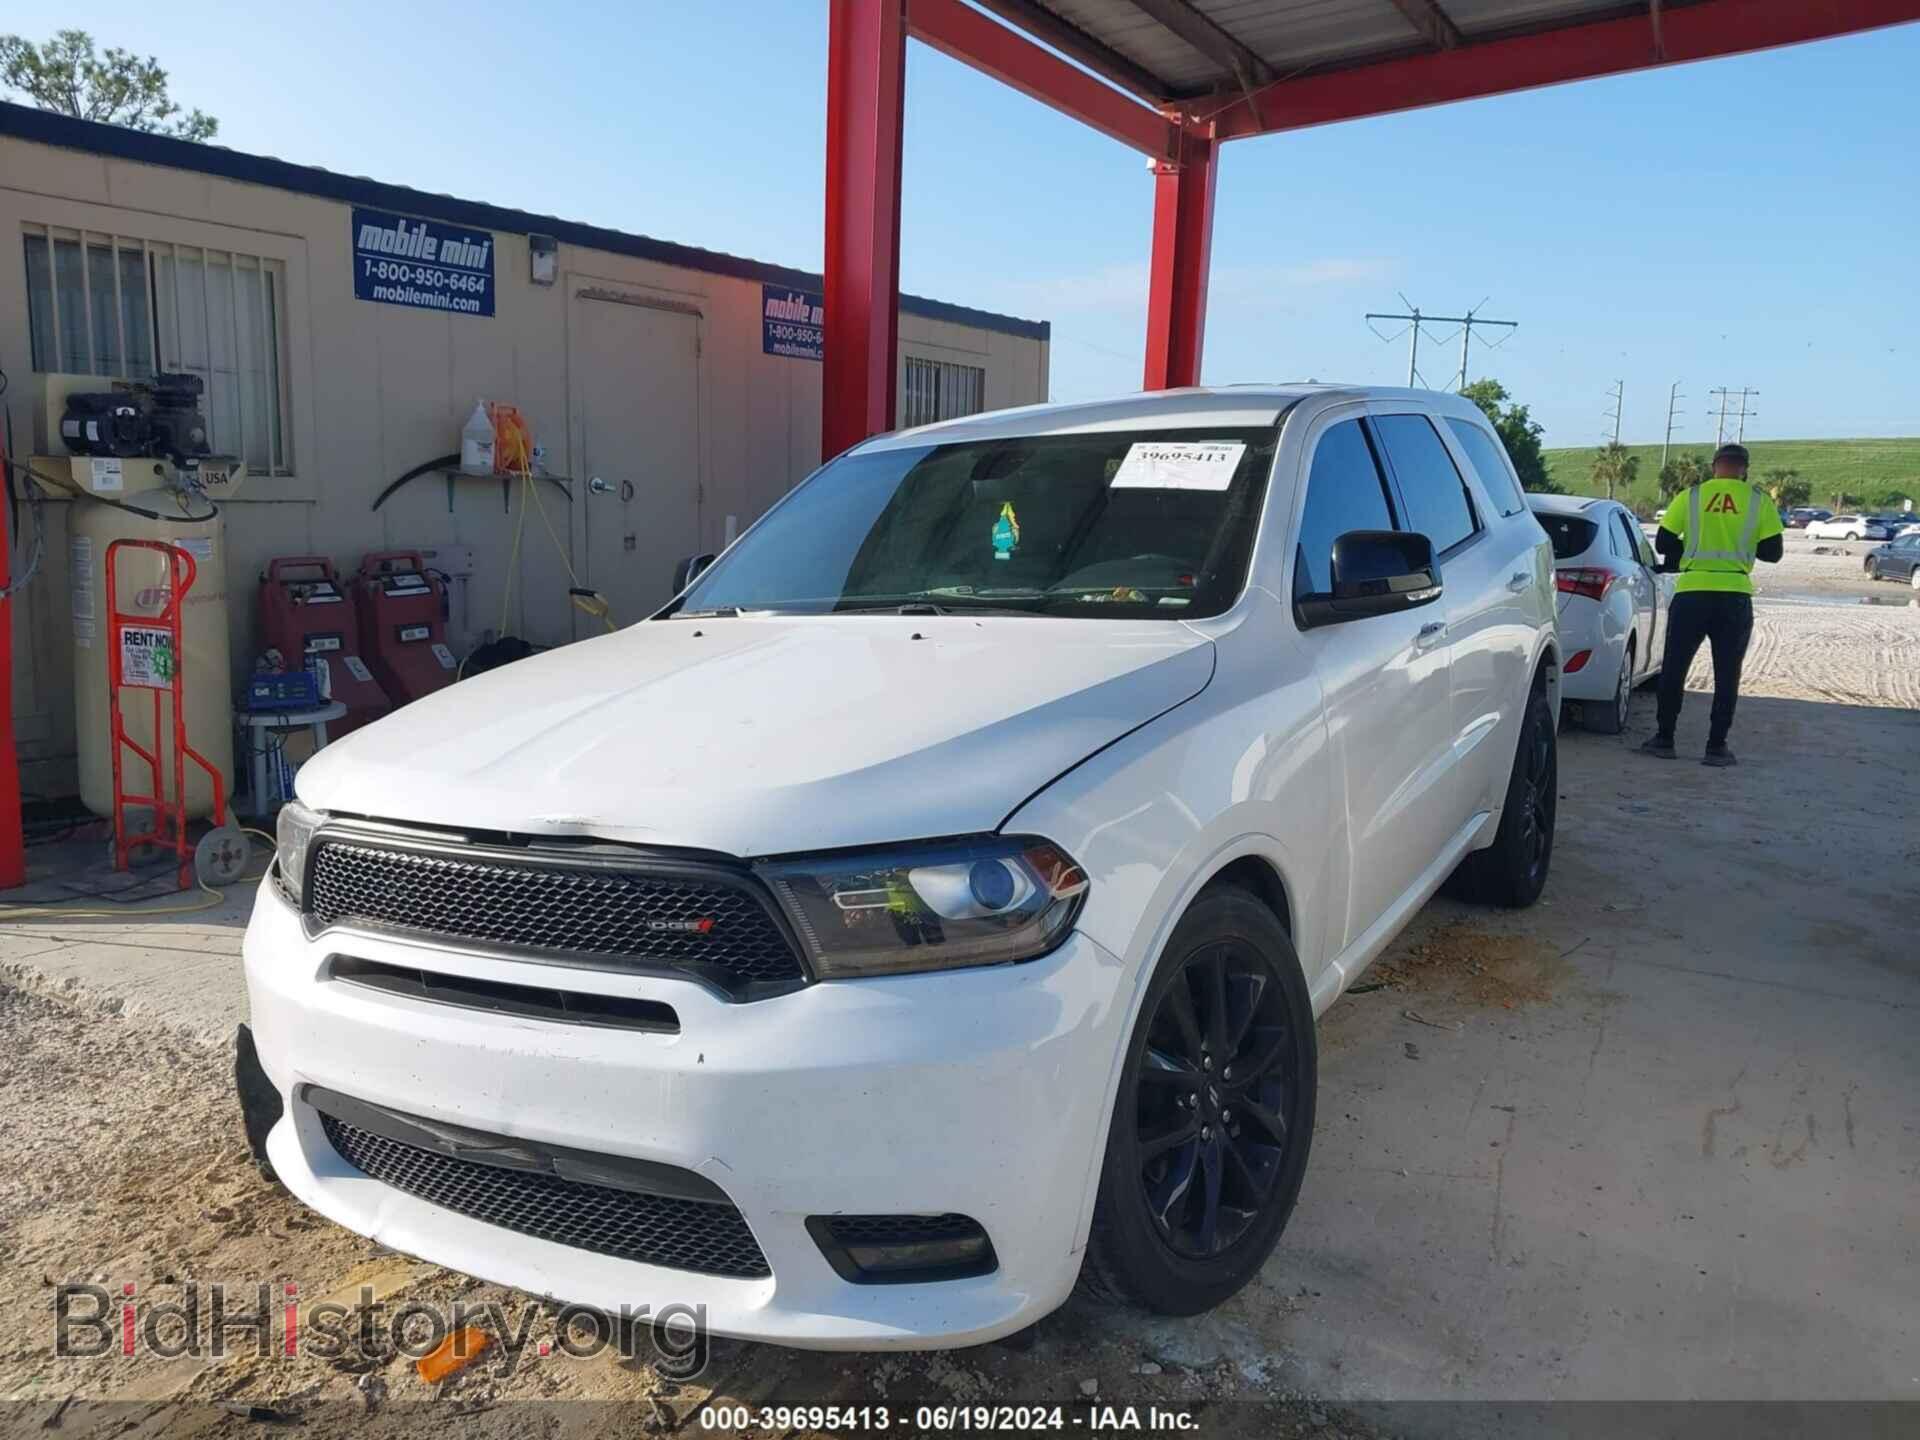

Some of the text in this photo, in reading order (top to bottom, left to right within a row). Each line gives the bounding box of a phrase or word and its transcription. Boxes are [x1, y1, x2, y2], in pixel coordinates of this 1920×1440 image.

[358, 219, 490, 269] mobile mini
[364, 259, 486, 294] 1-800-950-6464
[373, 285, 480, 312] mobilemini.com
[765, 292, 810, 323] mobile
[205, 471, 229, 485] USA
[124, 631, 154, 647] RENT
